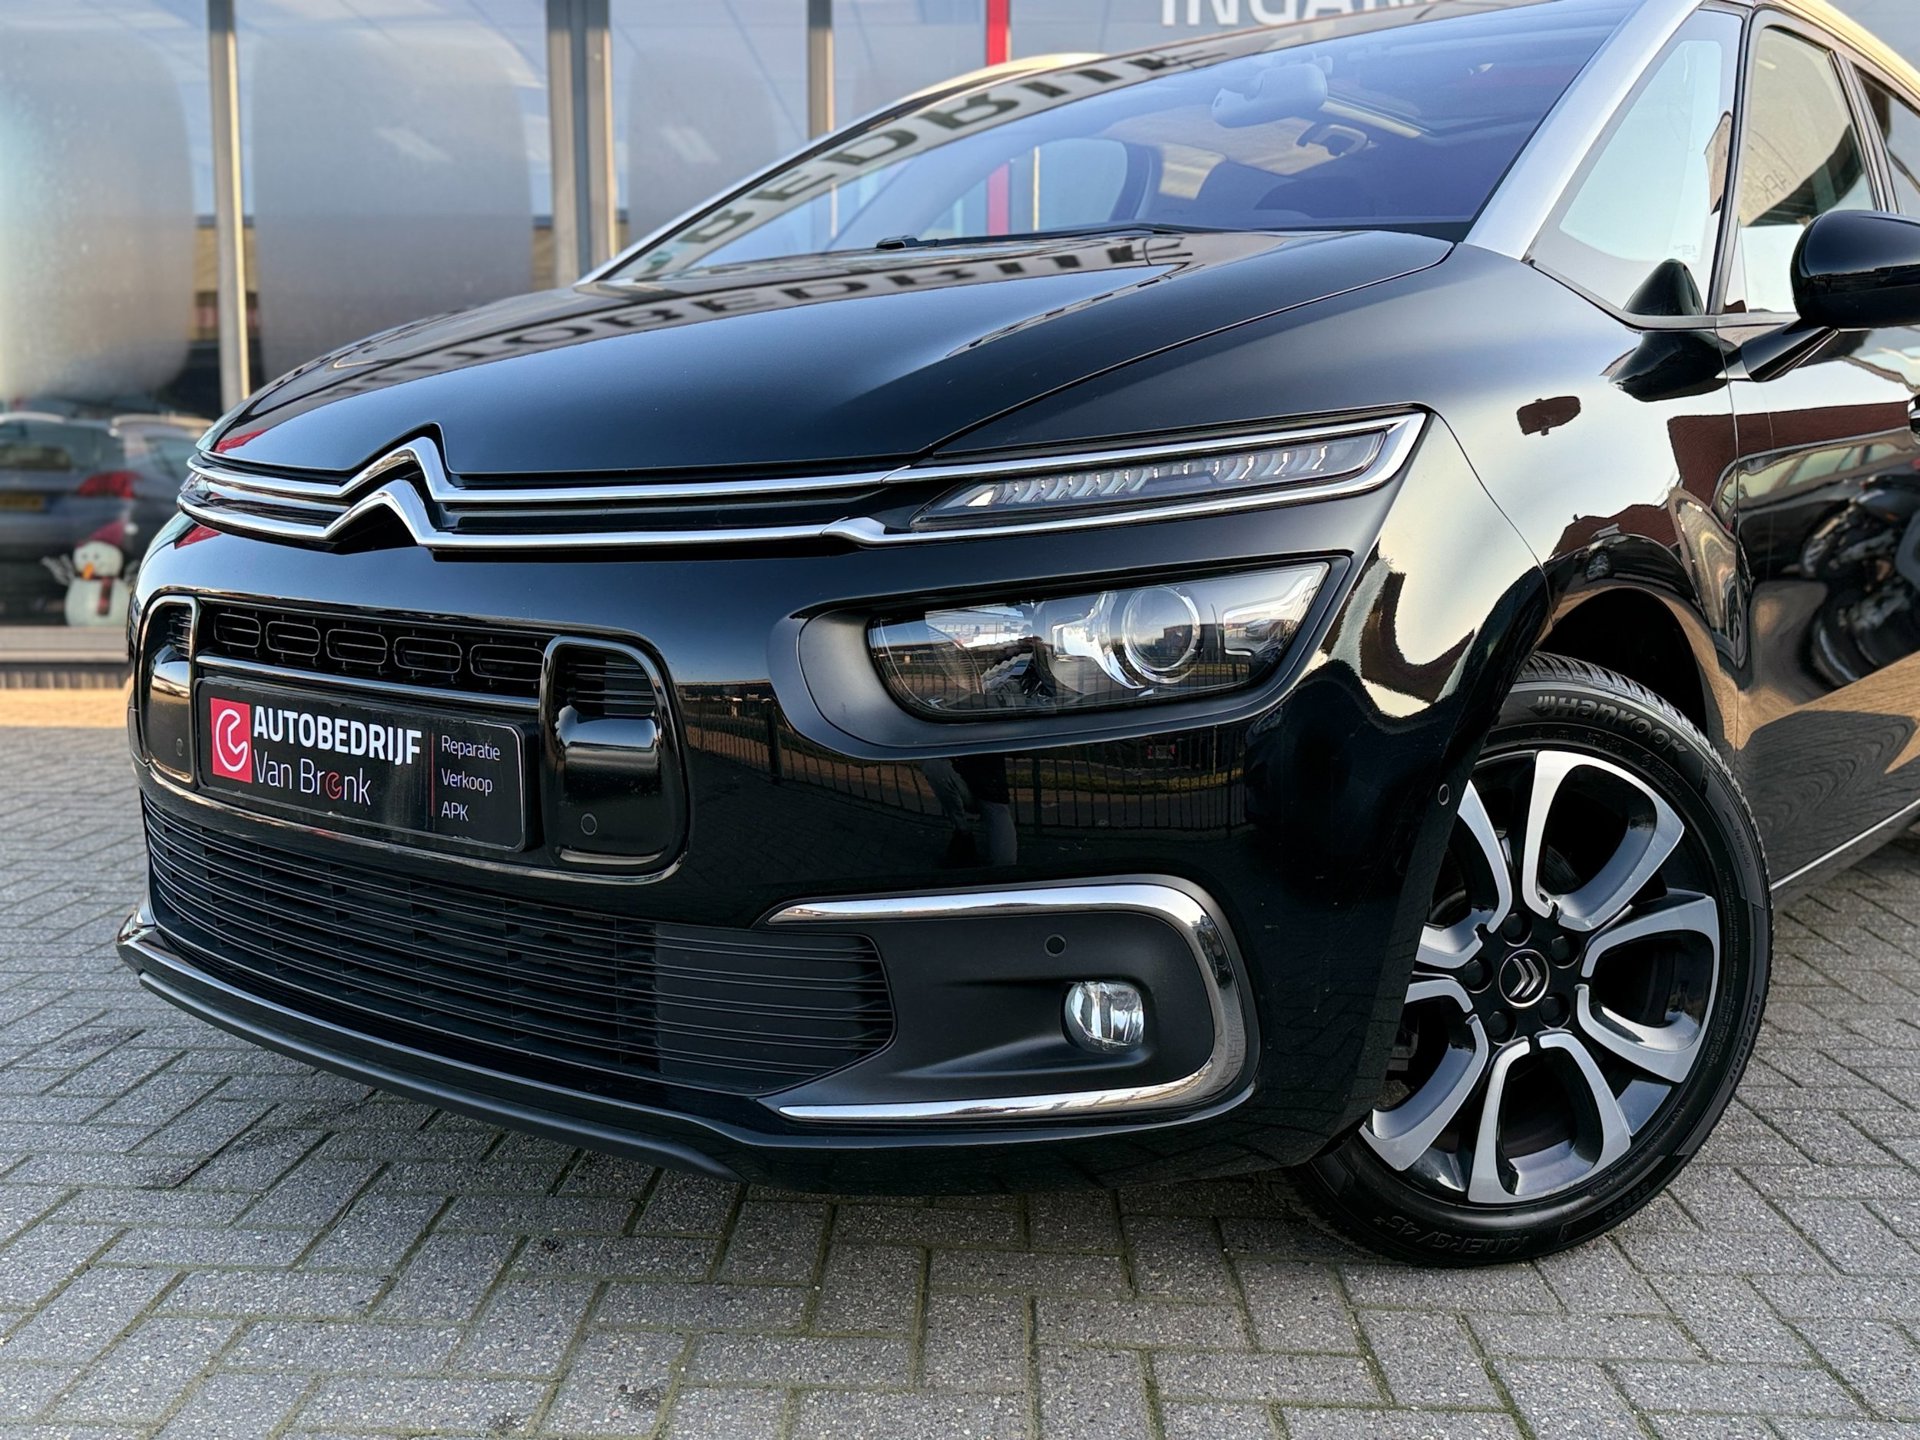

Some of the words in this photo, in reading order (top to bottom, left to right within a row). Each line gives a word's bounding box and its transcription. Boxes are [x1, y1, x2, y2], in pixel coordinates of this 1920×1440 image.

[253, 705, 422, 766] AUTOBEDRIJF
[1554, 696, 1688, 753] Hankook
[441, 735, 501, 762] Reparatie
[253, 749, 293, 790] Van
[441, 768, 494, 797] Verkoop
[441, 802, 469, 822] APK
